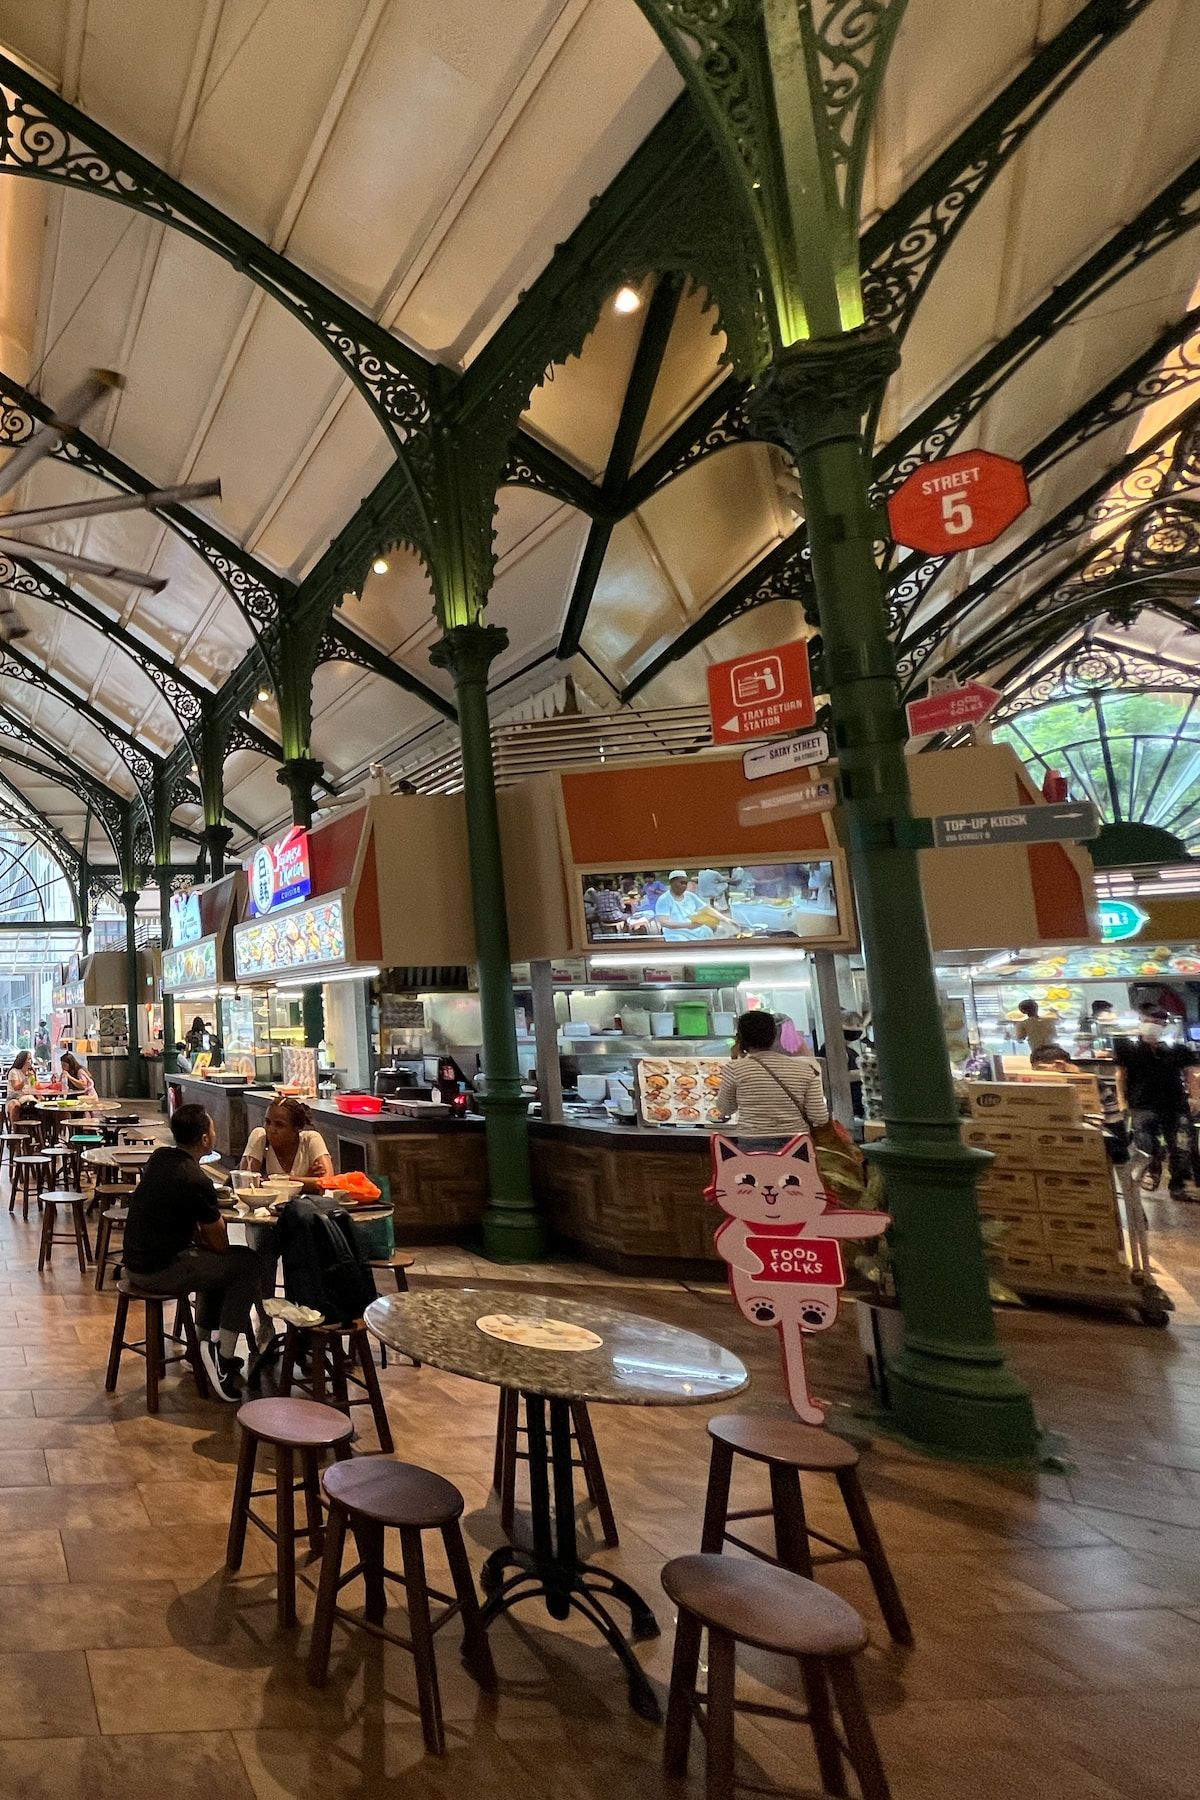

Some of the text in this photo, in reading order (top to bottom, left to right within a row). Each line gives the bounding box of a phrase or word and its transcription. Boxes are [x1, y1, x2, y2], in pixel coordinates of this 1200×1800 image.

[921, 467, 980, 495] STREET
[942, 490, 974, 535] 5
[742, 699, 803, 722] TRAY RETURN
[743, 715, 781, 733] STATION
[769, 737, 821, 760] SATAY STREET
[943, 814, 1028, 833] TOP-UP KIOSK
[770, 1247, 818, 1262] FOOD
[770, 1260, 824, 1275] FOLKS
